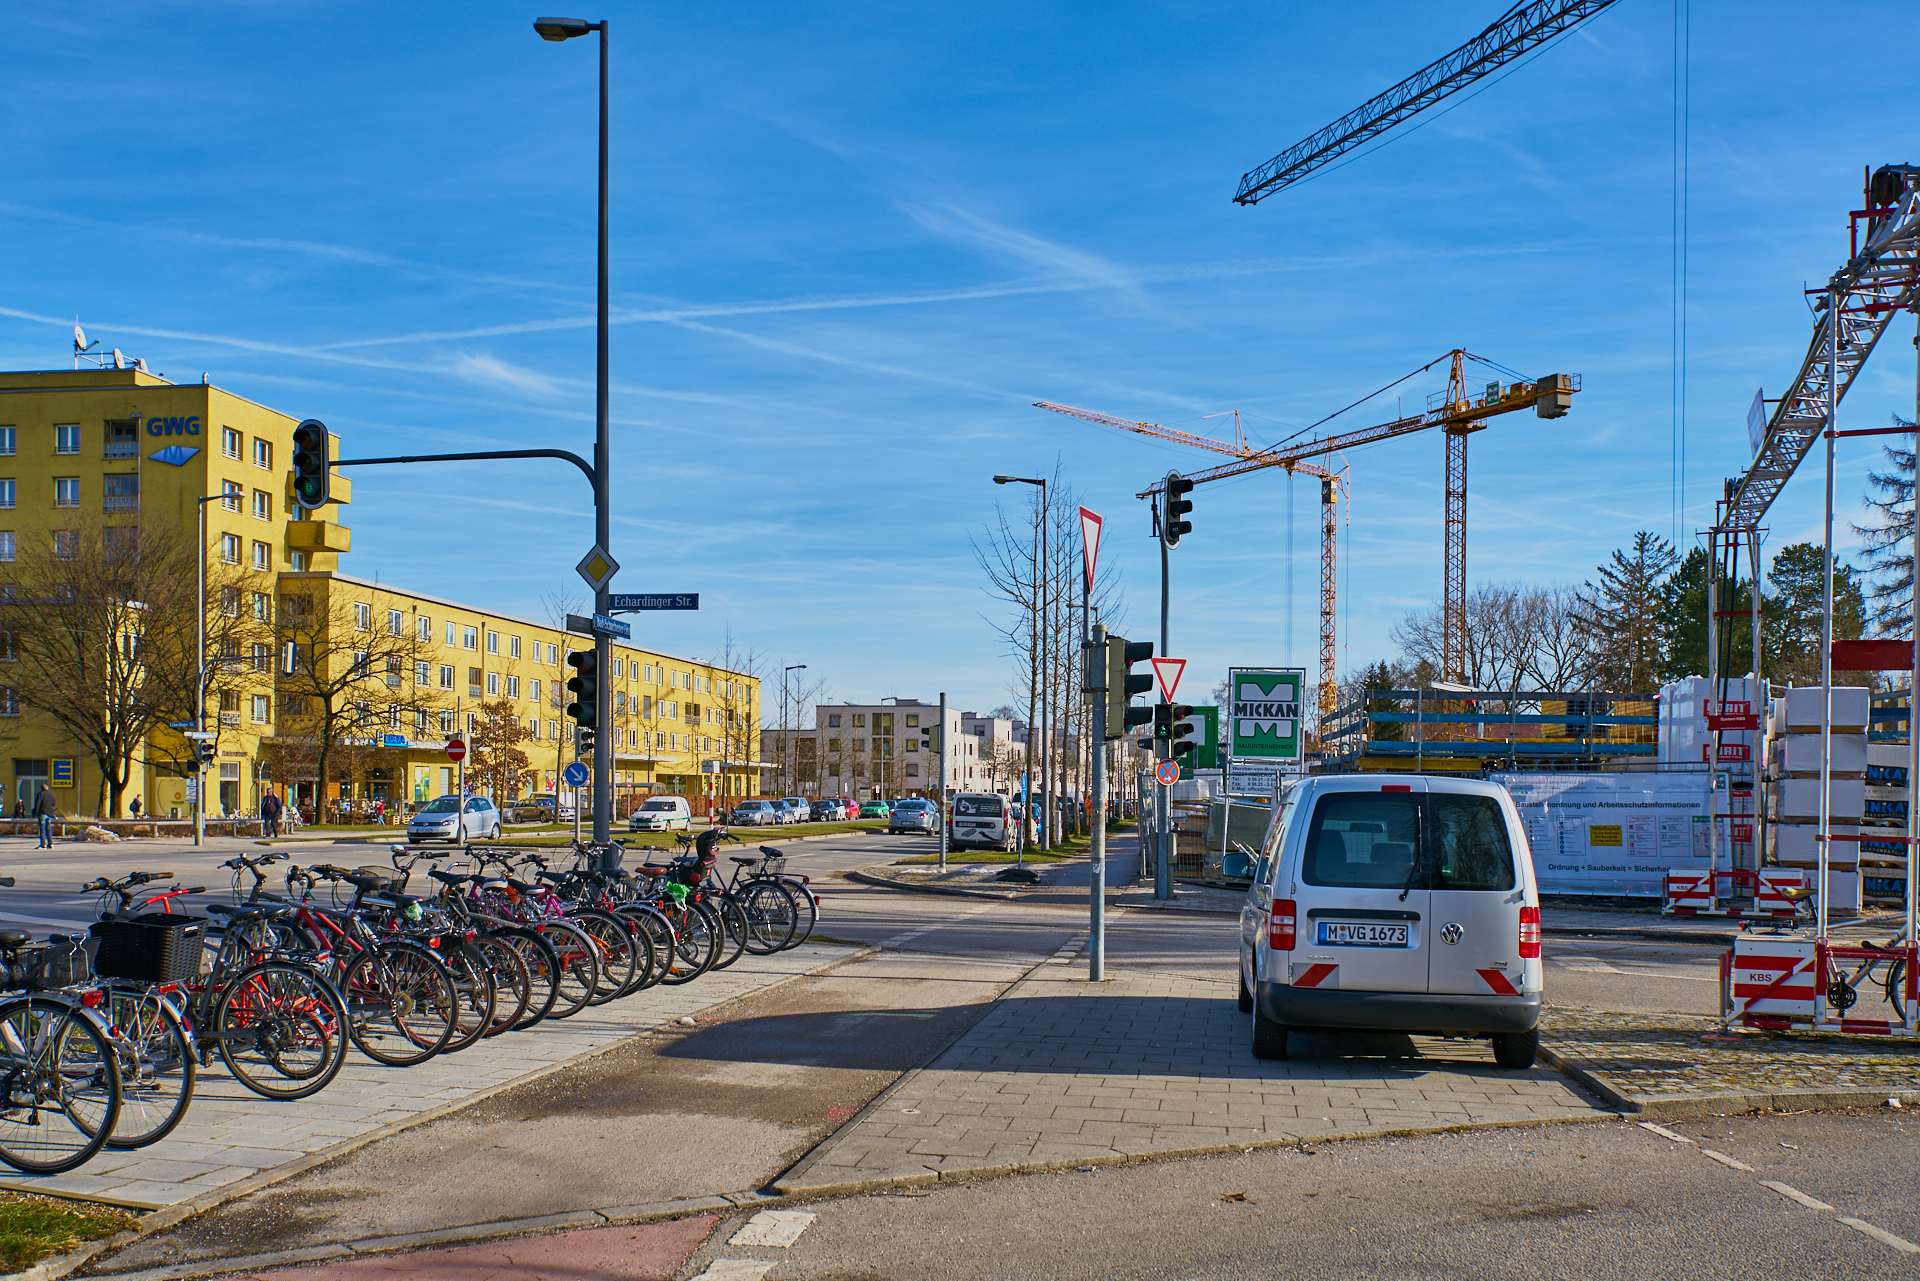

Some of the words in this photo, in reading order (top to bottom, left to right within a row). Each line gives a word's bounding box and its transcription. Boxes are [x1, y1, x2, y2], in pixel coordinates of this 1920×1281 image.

[147, 416, 200, 436] GWG
[614, 595, 673, 609] Echardinger
[675, 595, 693, 607] Str.
[1234, 703, 1299, 717] MICKAN
[1548, 864, 1579, 872] Ordnung
[1328, 925, 1338, 939] M
[1347, 926, 1366, 940] VG
[1369, 927, 1406, 941] 1673
[1749, 973, 1772, 982] KBS
